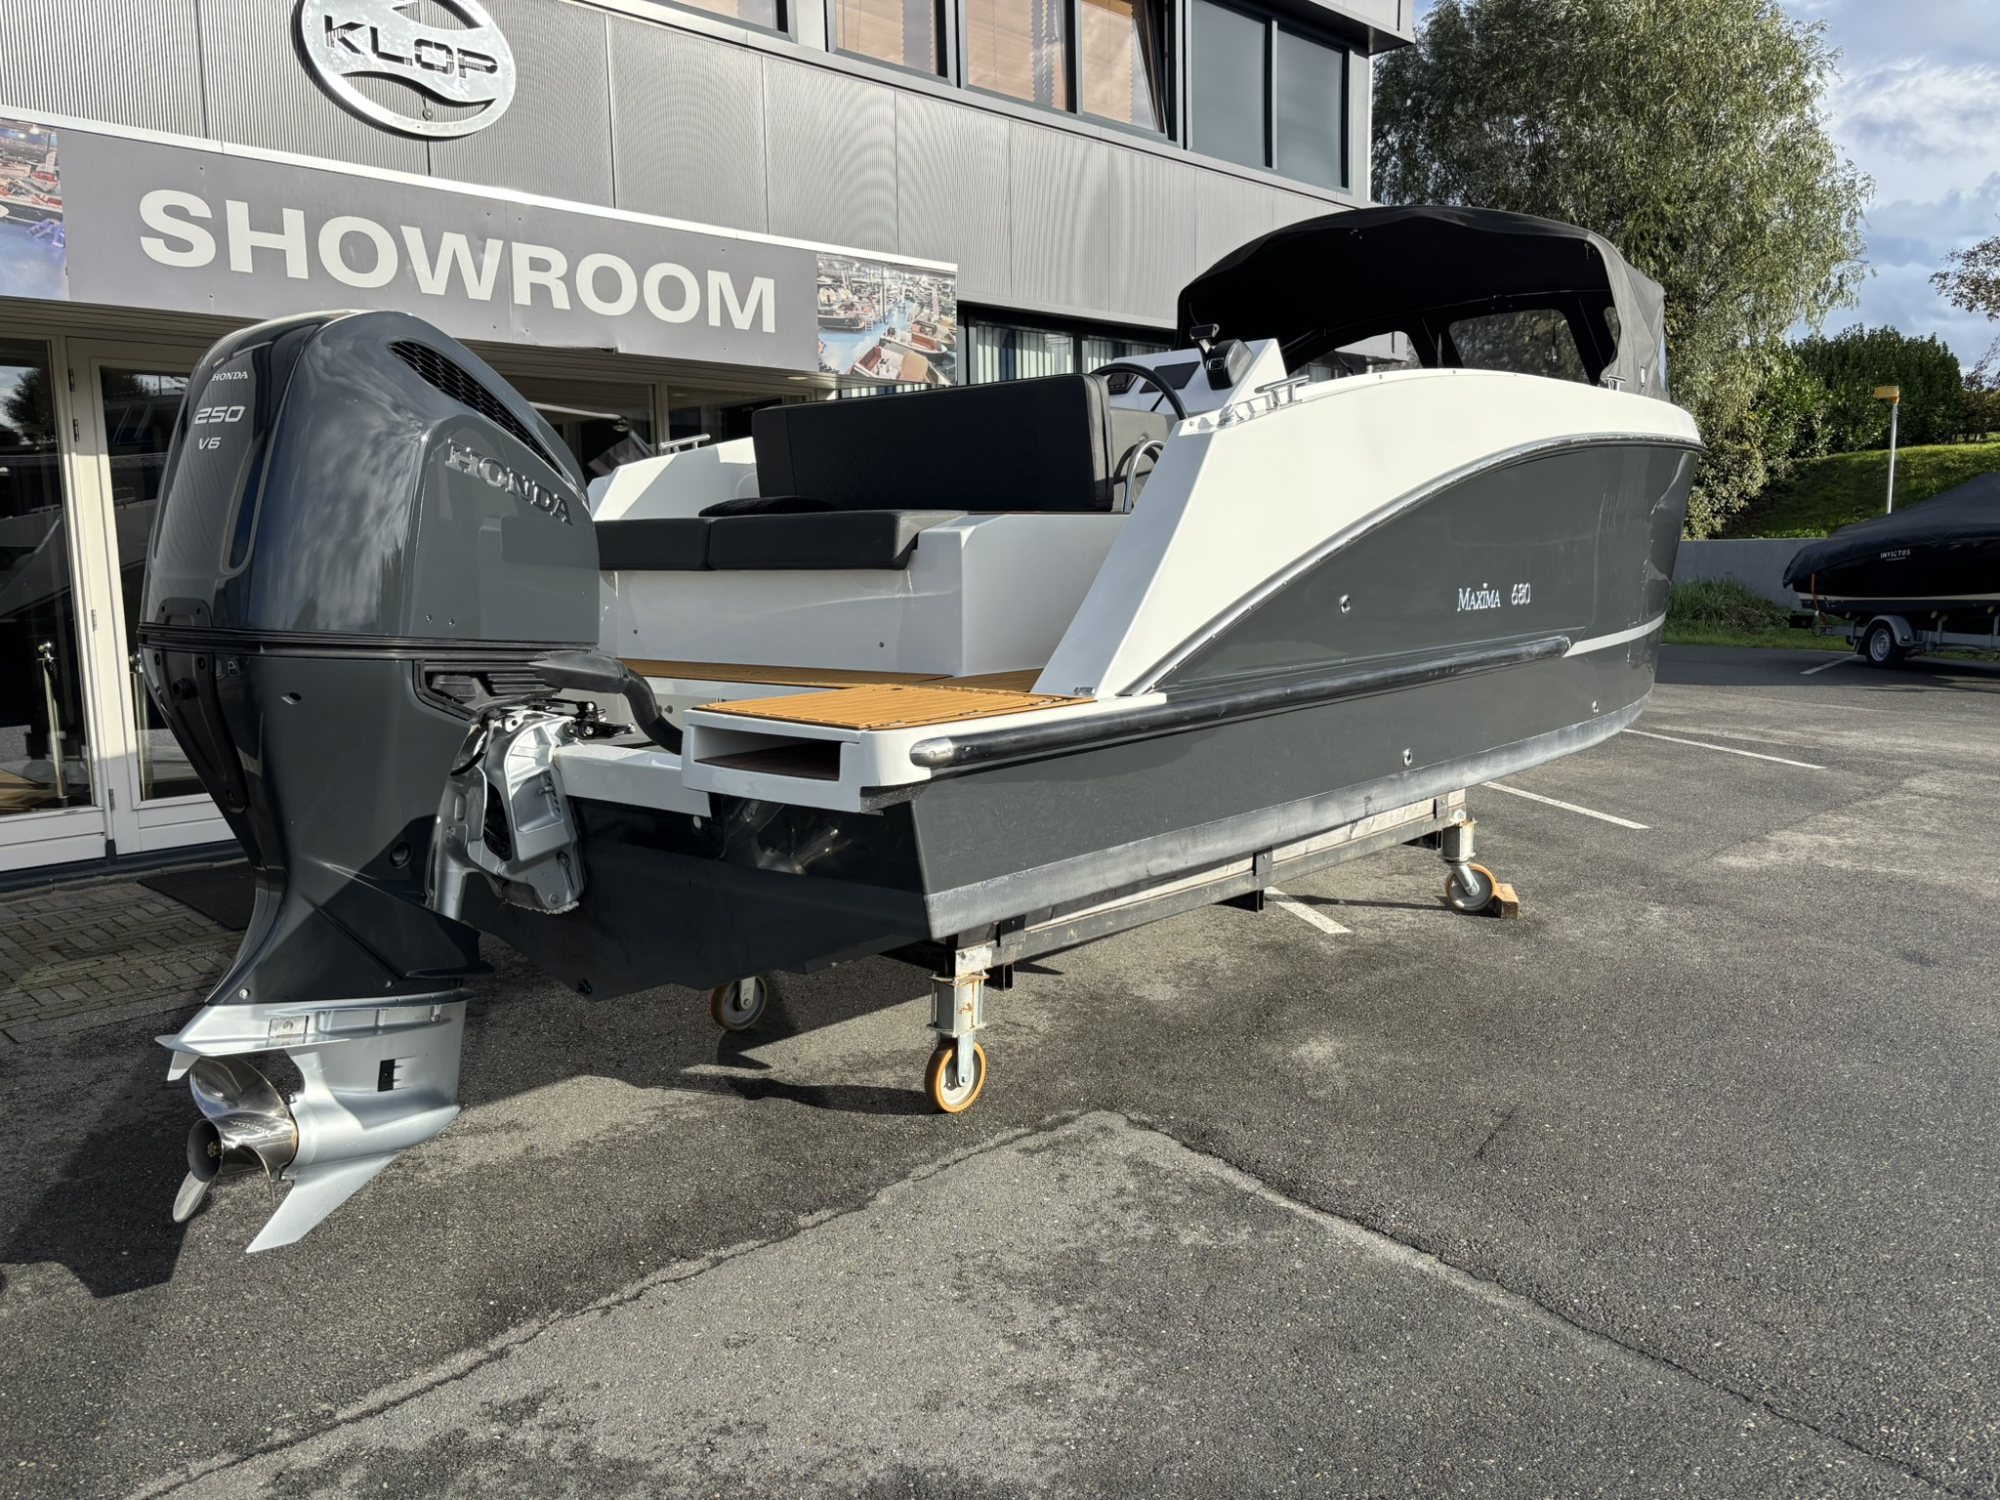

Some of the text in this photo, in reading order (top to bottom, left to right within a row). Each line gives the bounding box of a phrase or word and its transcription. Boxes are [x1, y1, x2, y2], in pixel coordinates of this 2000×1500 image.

[324, 14, 498, 79] KLOP
[138, 189, 776, 333] SHOWROOM
[211, 371, 249, 381] HONDA
[194, 405, 245, 424] 250
[198, 436, 222, 450] V6
[444, 438, 573, 527] HONDA
[1880, 548, 1911, 559] INVICTUS
[229, 1120, 272, 1138] HONDA
